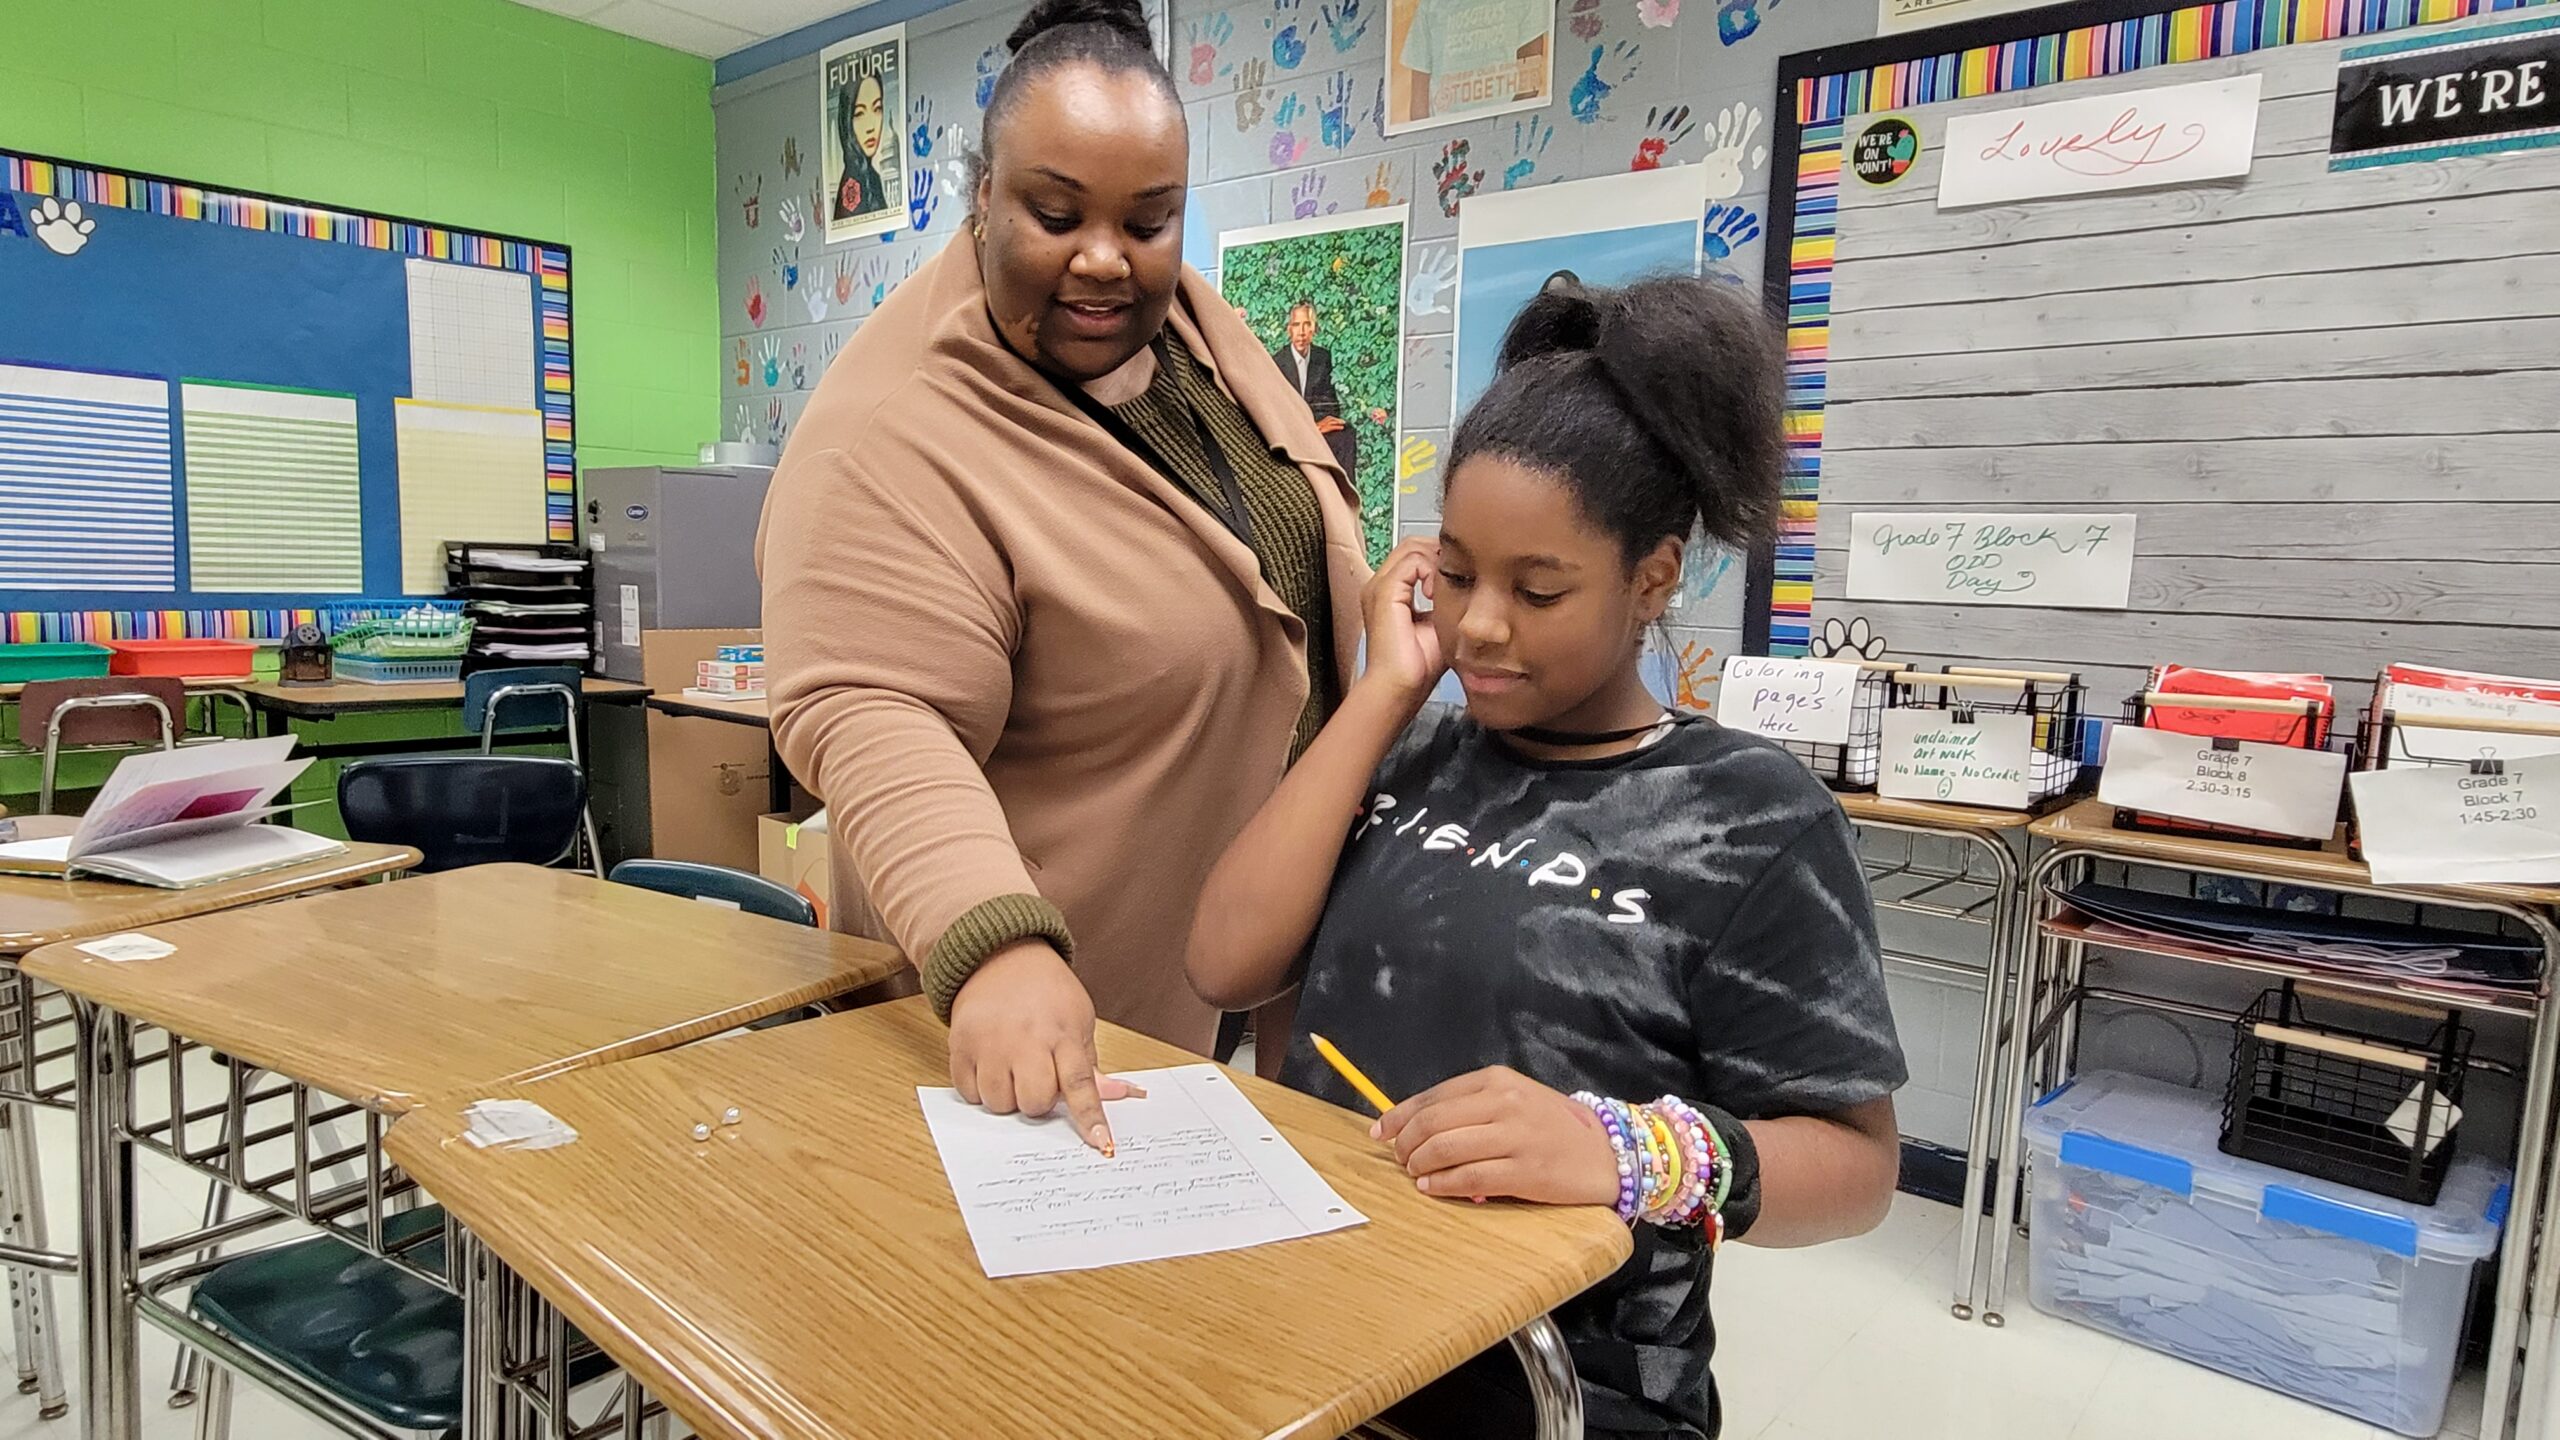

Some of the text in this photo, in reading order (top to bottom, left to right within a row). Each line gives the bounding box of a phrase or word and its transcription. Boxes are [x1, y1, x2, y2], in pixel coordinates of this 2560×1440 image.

[830, 48, 896, 90] FUTURE
[2377, 60, 2548, 127] WE'RE
[1859, 132, 1893, 148] WE'RE
[1980, 107, 2206, 177] Lovely
[1863, 147, 1880, 161] ON
[1855, 158, 1892, 175] POINT!
[1872, 522, 2112, 556] Grade 7 Block 7
[1946, 553, 2003, 571] ODD
[1946, 570, 2037, 597] Day
[1759, 713, 1800, 733] Here
[2197, 749, 2253, 767] Grade 7
[1894, 763, 1909, 775] No
[1914, 764, 1946, 776] Name
[1961, 766, 1980, 778] No
[1982, 767, 2022, 782] Credit
[2196, 765, 2247, 782] Block 8
[2457, 772, 2524, 790] Grade 7
[2186, 780, 2251, 799] 2:30-3:15
[2463, 790, 2524, 807] Block 7
[2459, 807, 2537, 825] 1:45-2:30
